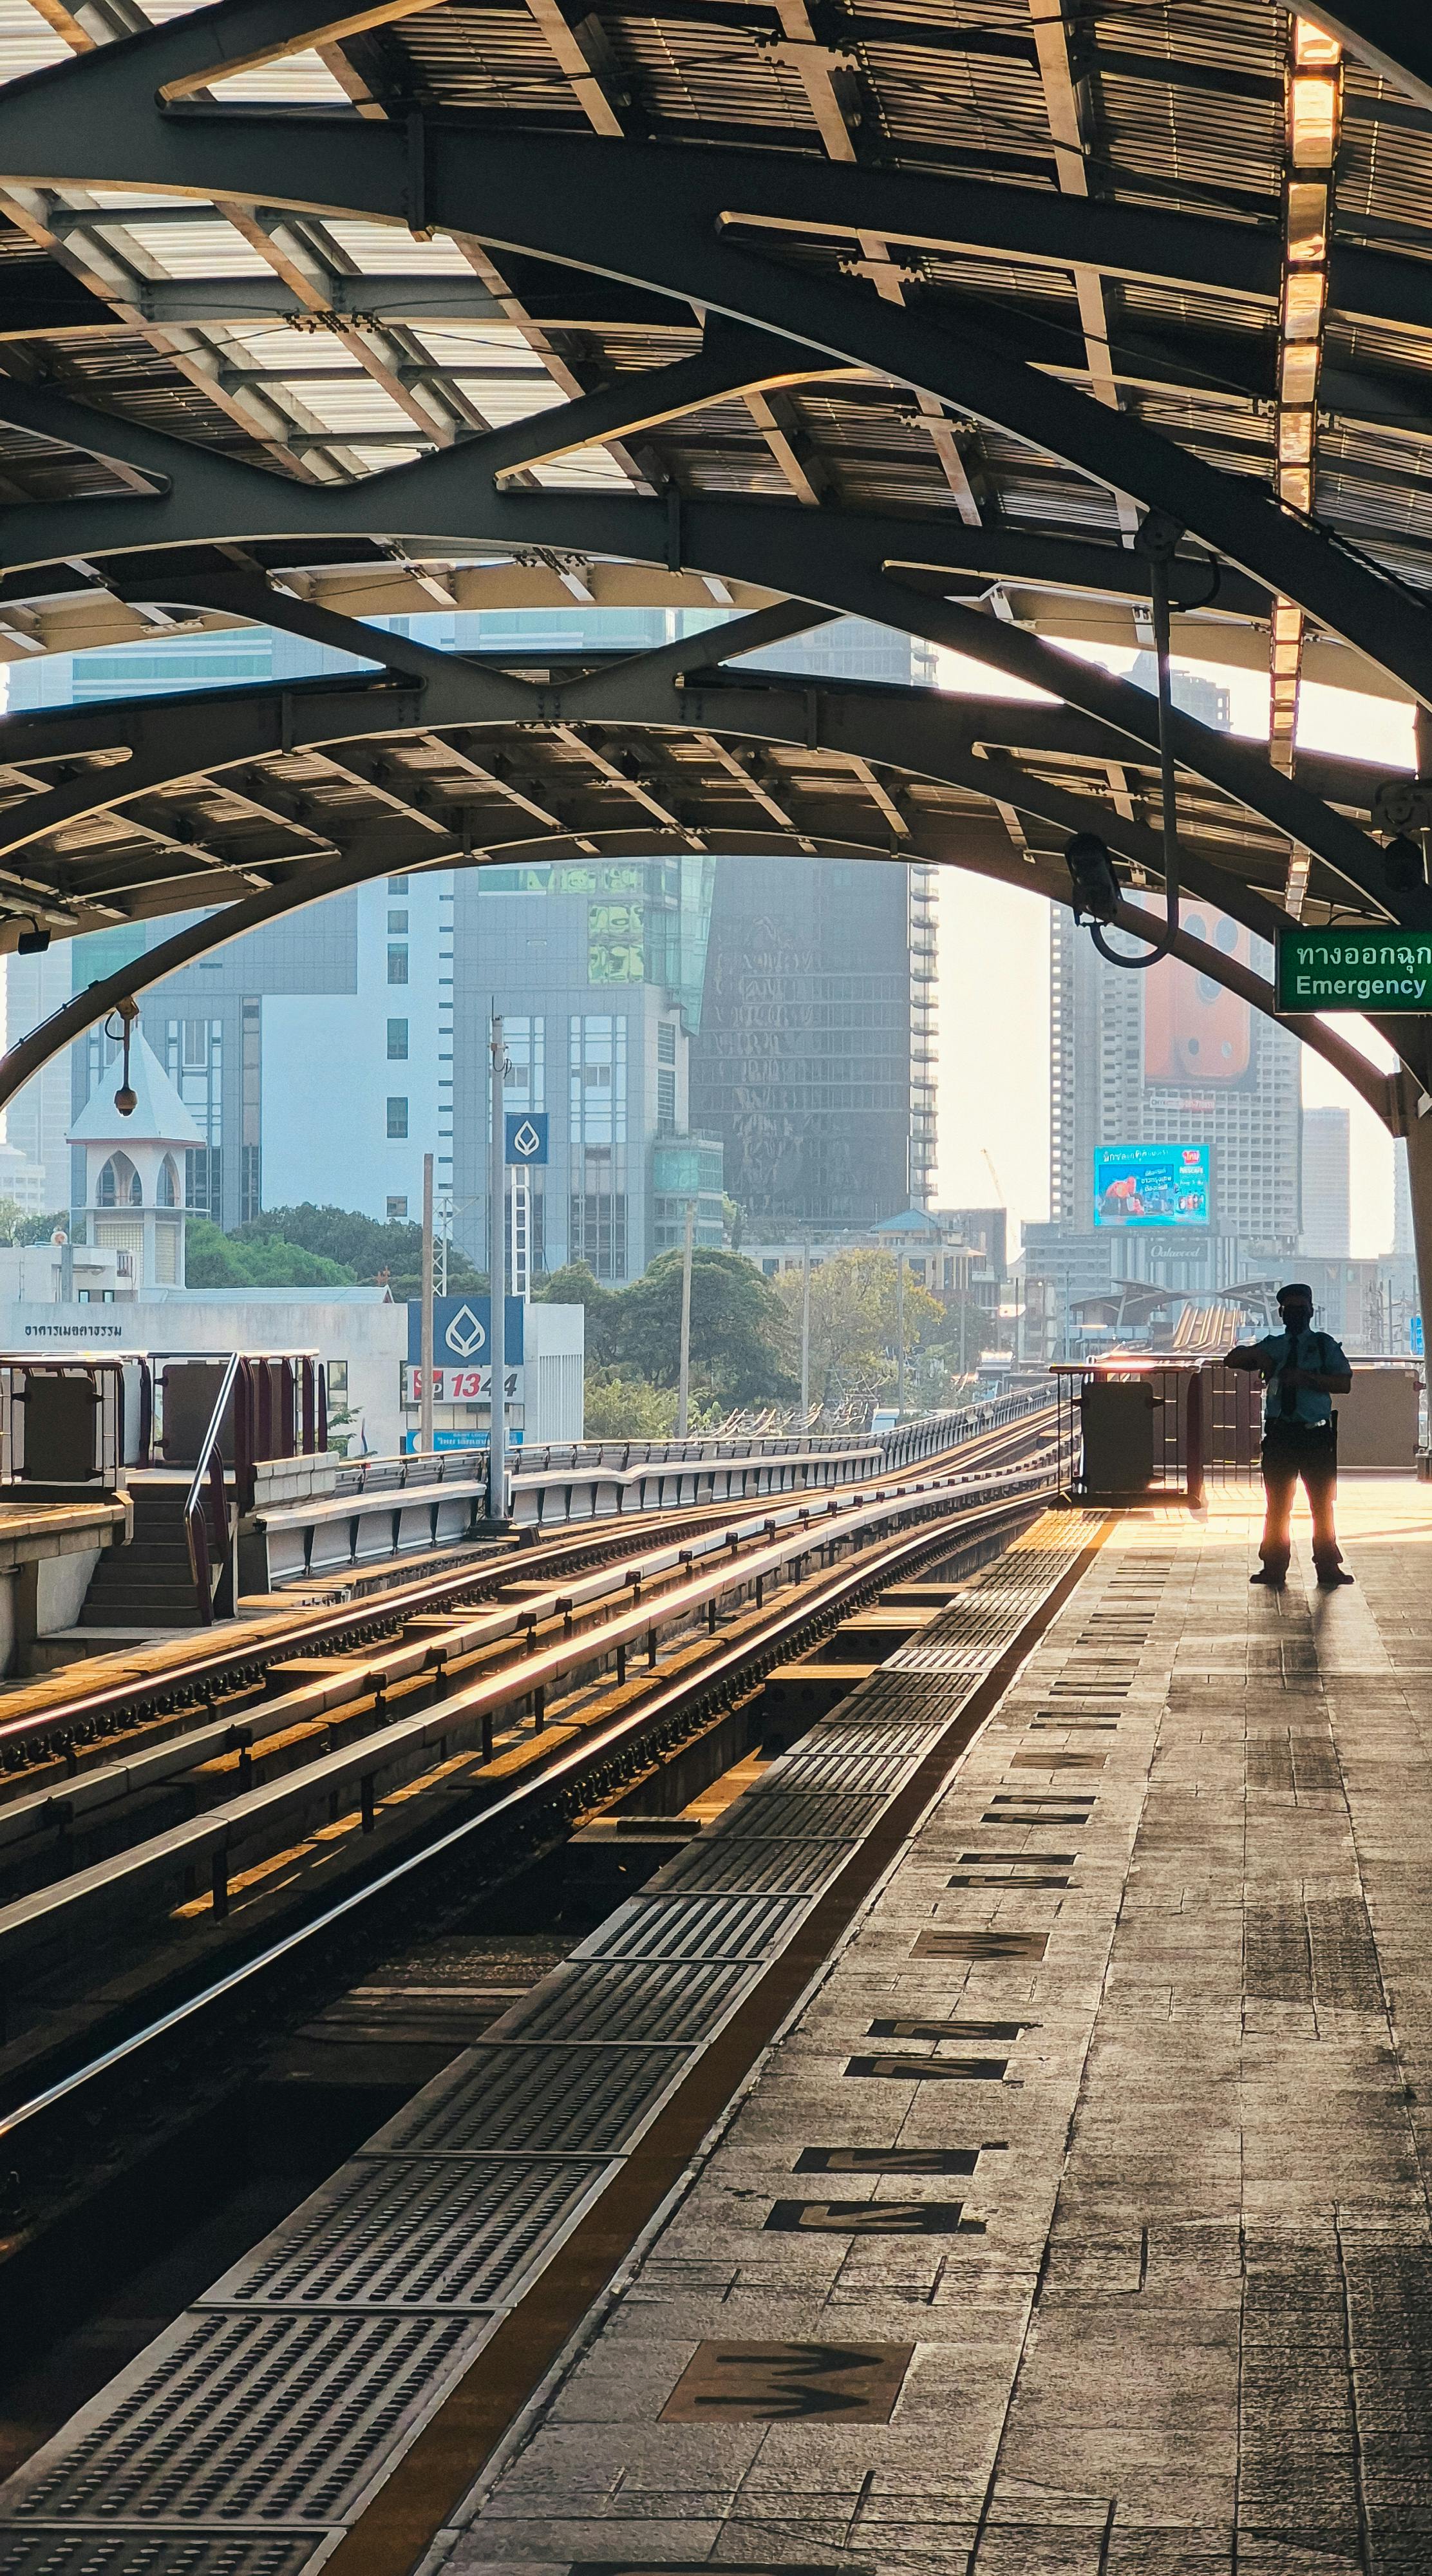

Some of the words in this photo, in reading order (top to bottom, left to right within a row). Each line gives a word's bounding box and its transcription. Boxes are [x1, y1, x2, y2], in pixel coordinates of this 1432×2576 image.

[1297, 976, 1427, 999] Emergency
[1151, 1245, 1200, 1258] Oakwood
[451, 1373, 518, 1397] 1344
